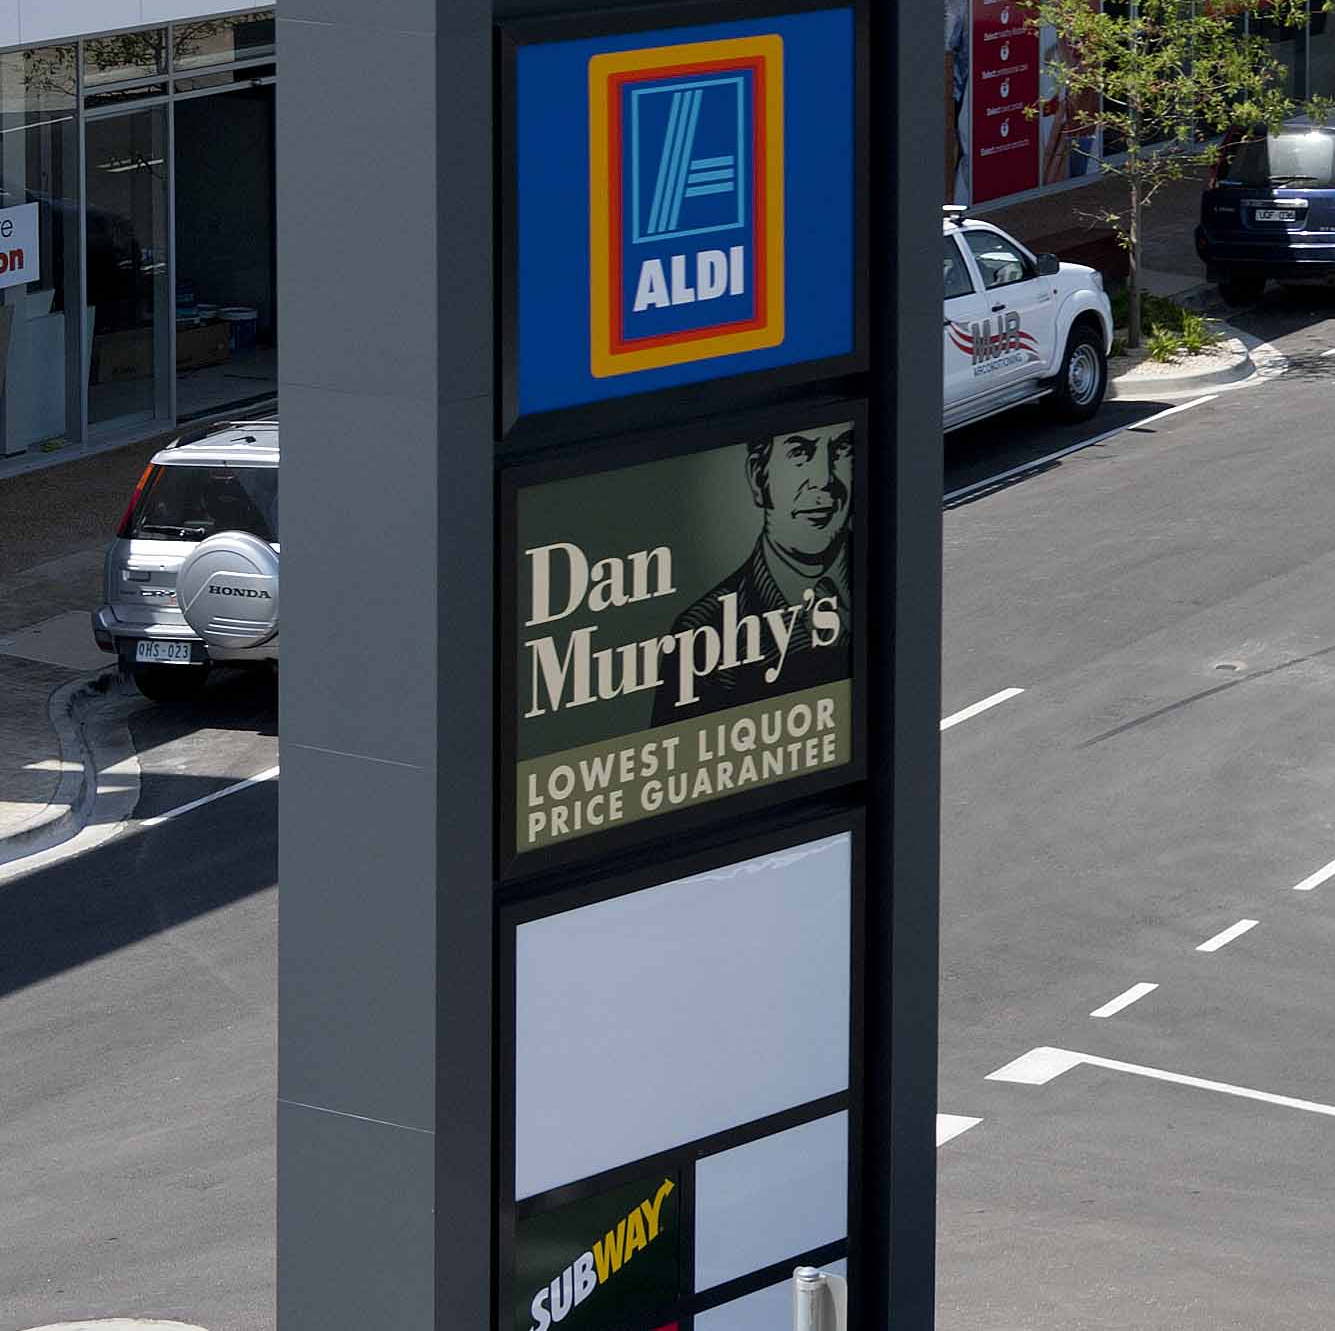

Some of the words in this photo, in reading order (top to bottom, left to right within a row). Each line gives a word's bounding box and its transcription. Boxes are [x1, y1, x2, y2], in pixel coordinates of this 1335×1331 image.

[632, 245, 744, 312] ALDI
[209, 585, 272, 599] HONDA
[525, 541, 677, 627] Dan
[525, 588, 841, 719] Murphy's
[528, 737, 680, 807] LOWEST
[699, 698, 836, 763] LIQUOR
[528, 789, 624, 843] PRICE
[640, 733, 836, 812] GUARANTEE
[529, 1178, 675, 1331] SUBWAY
